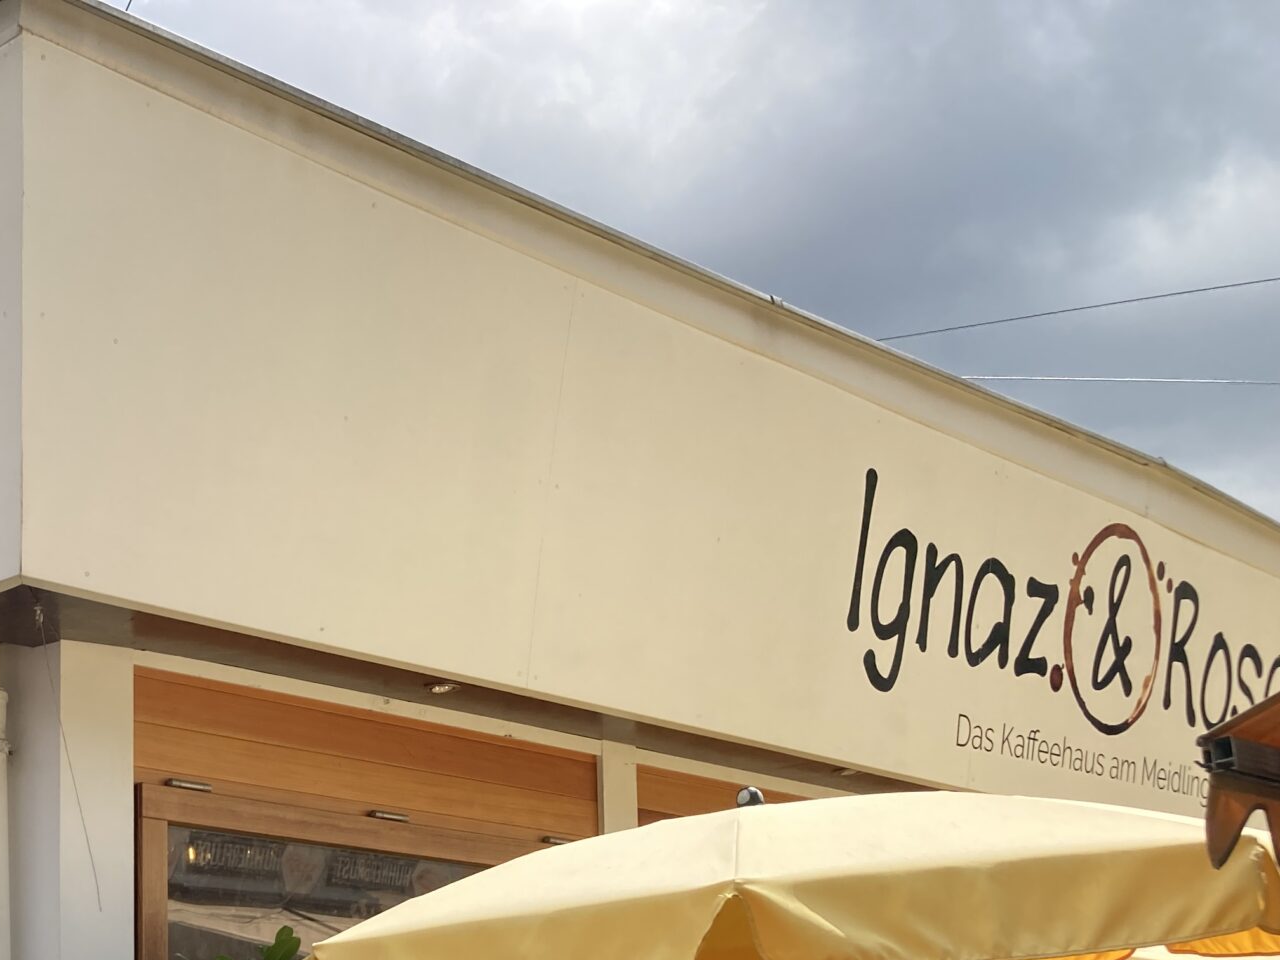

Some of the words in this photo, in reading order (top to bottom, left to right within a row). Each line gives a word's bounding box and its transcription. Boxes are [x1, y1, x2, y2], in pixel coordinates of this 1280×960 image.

[847, 468, 1060, 692] Ignaz
[1092, 555, 1133, 697] &
[955, 713, 995, 754] Das
[1000, 722, 1105, 777] Kaffeehaus
[1109, 754, 1137, 784] am
